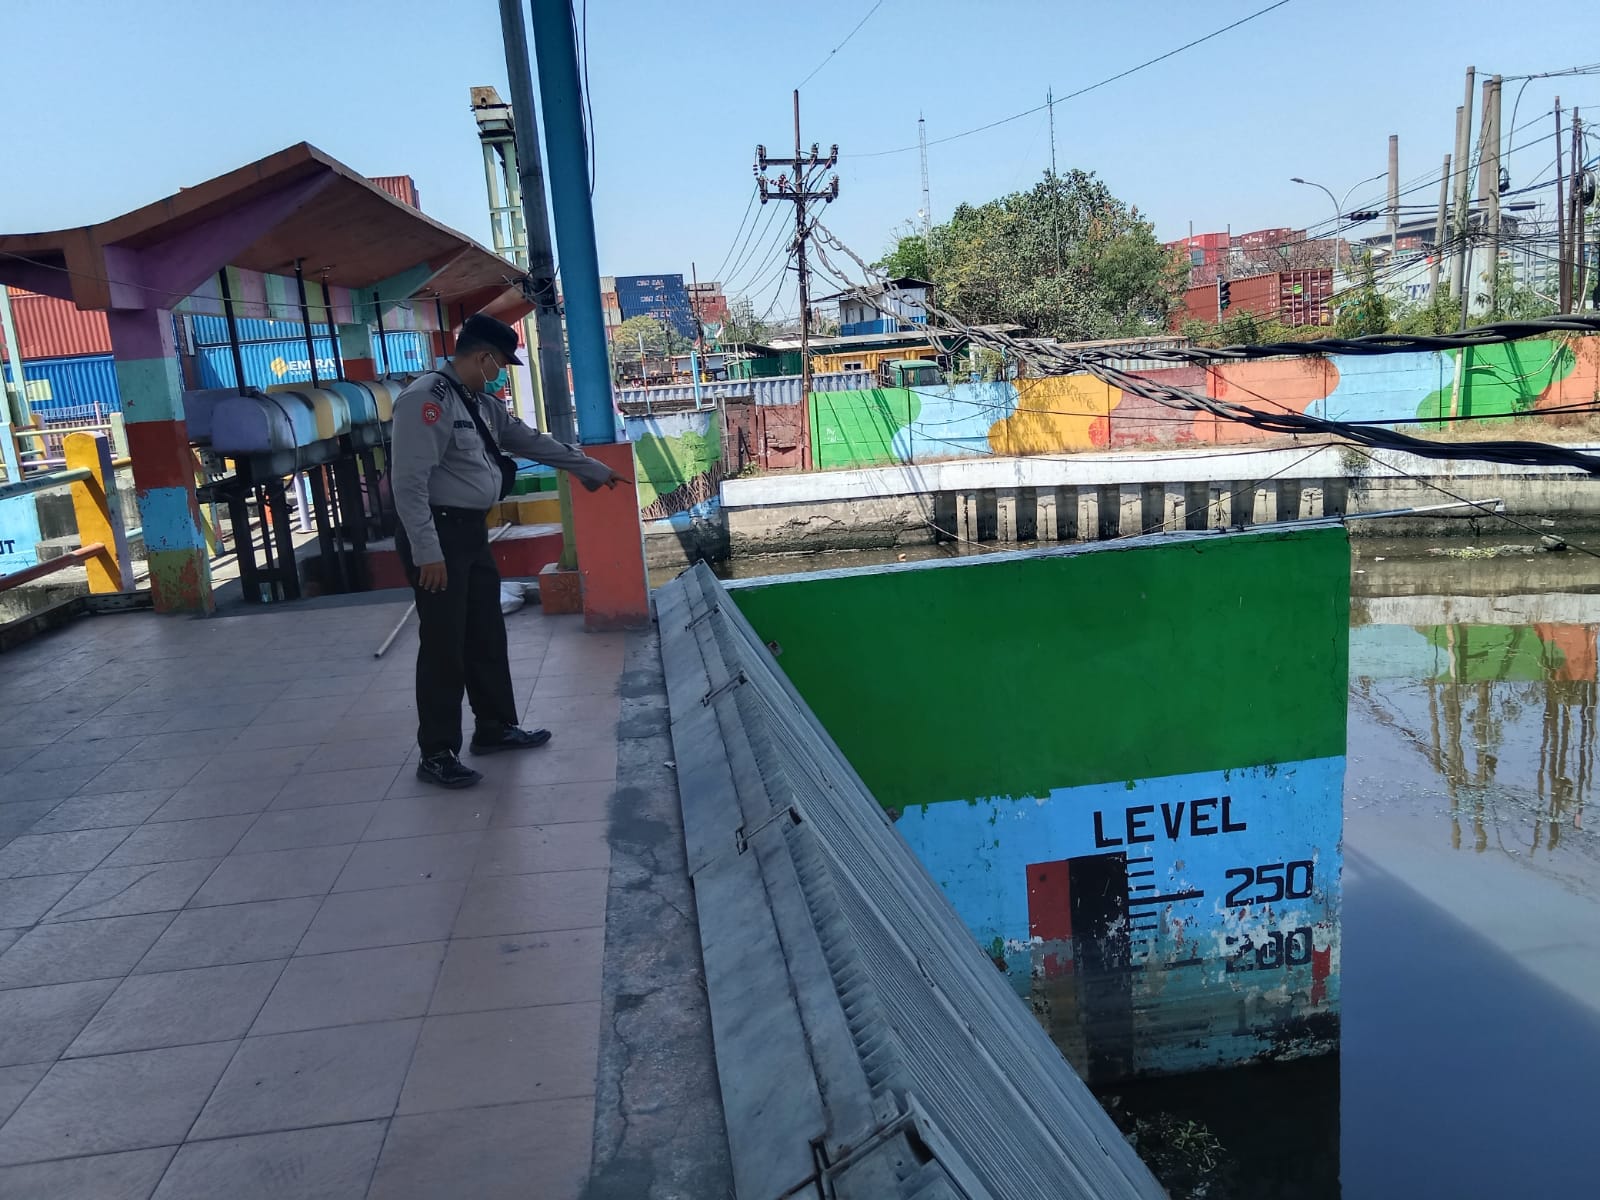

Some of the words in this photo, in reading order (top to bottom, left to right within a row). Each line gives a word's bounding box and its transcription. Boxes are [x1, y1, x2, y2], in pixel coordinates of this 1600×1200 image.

[1093, 796, 1247, 849] LEVEL
[1225, 860, 1314, 908] 250
[1225, 926, 1313, 974] 200
